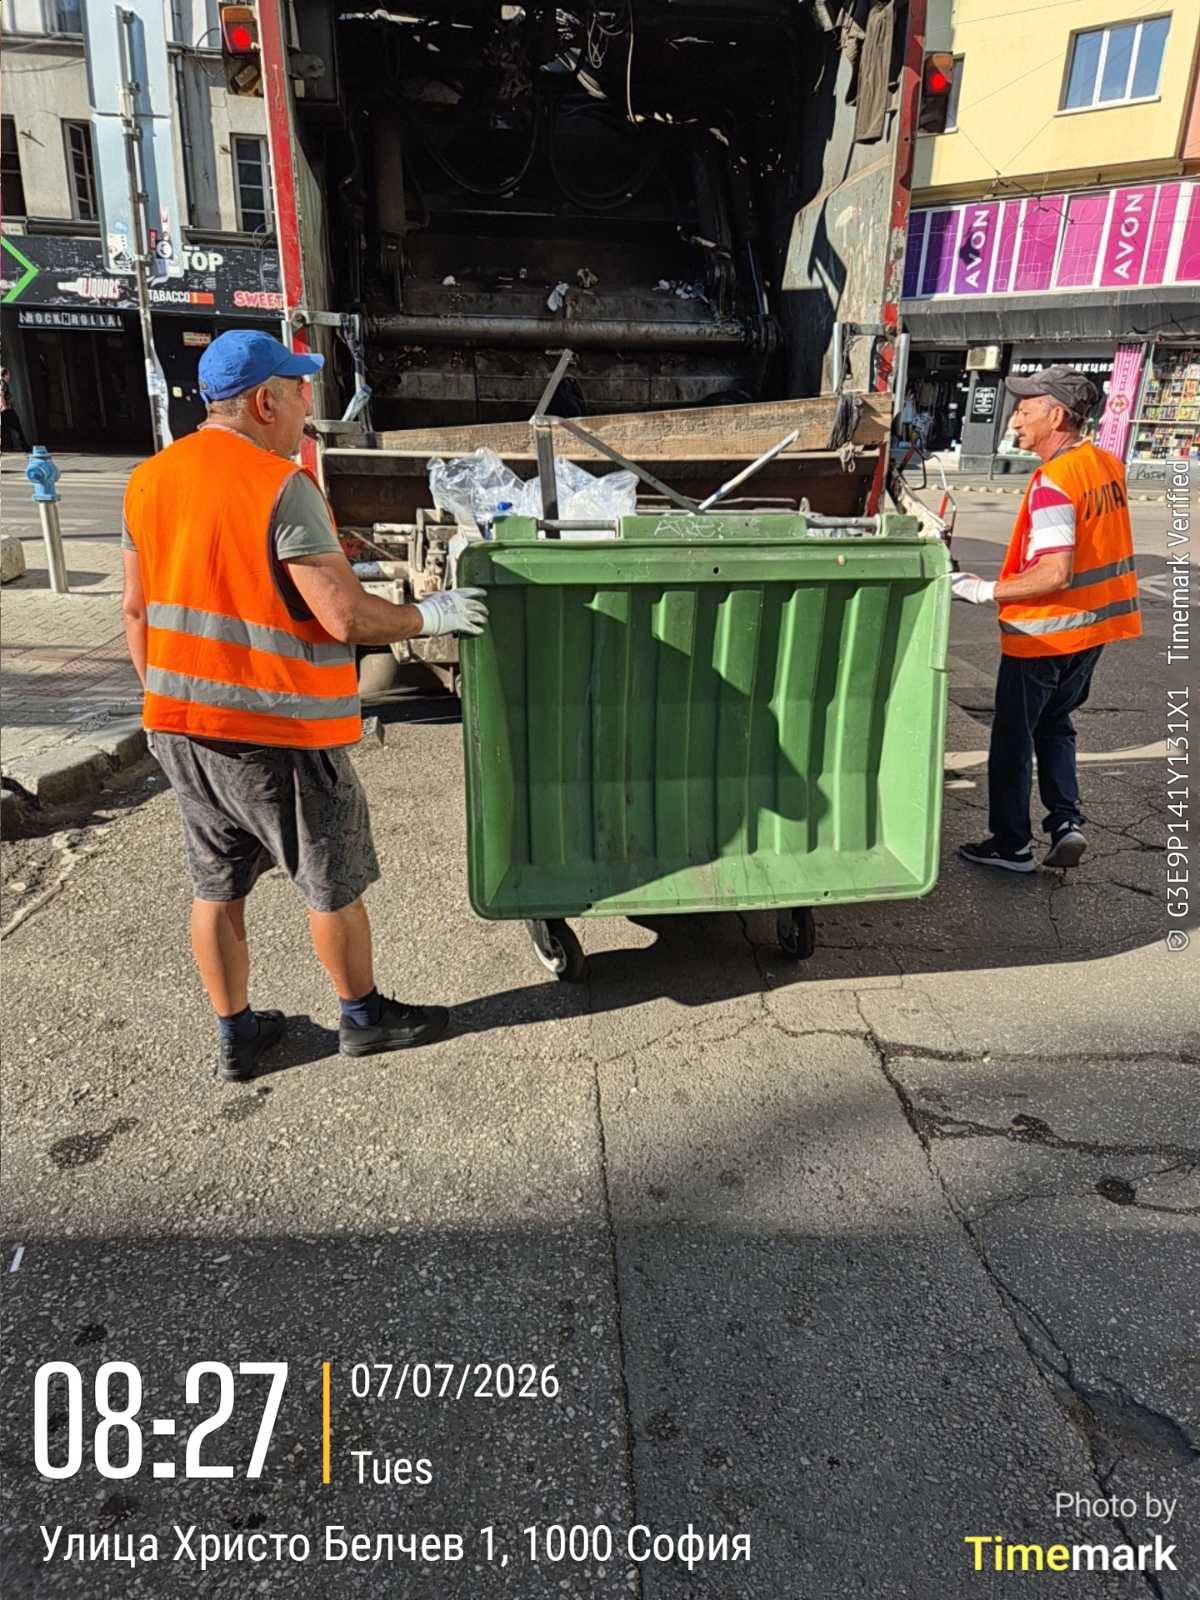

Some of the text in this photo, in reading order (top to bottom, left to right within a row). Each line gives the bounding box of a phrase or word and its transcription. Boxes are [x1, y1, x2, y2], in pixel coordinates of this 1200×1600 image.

[965, 210, 990, 288] AVON
[1113, 193, 1145, 279] AVON
[148, 289, 190, 304] TABACCO
[1011, 363, 1115, 374] НОВА ЕКЦИЯ
